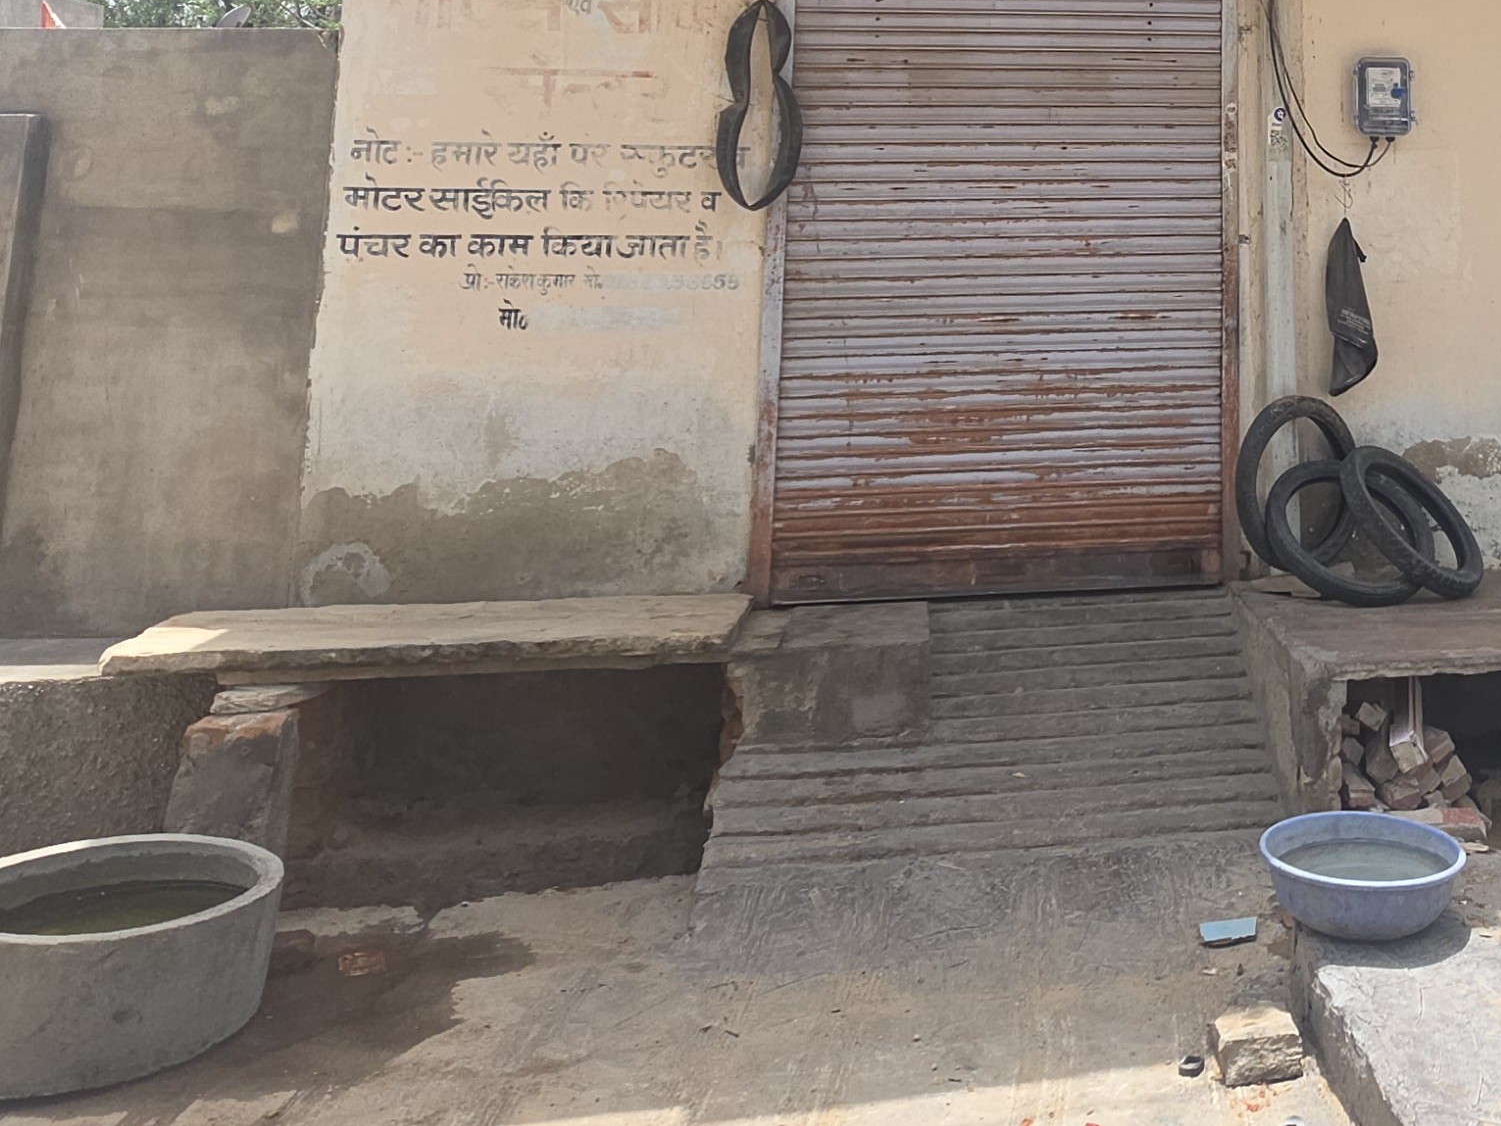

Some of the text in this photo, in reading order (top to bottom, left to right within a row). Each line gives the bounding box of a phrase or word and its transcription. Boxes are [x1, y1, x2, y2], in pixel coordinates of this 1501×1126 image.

[430, 129, 500, 171] हमारे
[569, 143, 611, 168] पर
[343, 172, 425, 212] मोटर
[336, 226, 412, 258] पंचर
[418, 234, 462, 258] का
[467, 234, 534, 259] काम
[541, 226, 615, 259] किया
[616, 234, 690, 260] जाता
